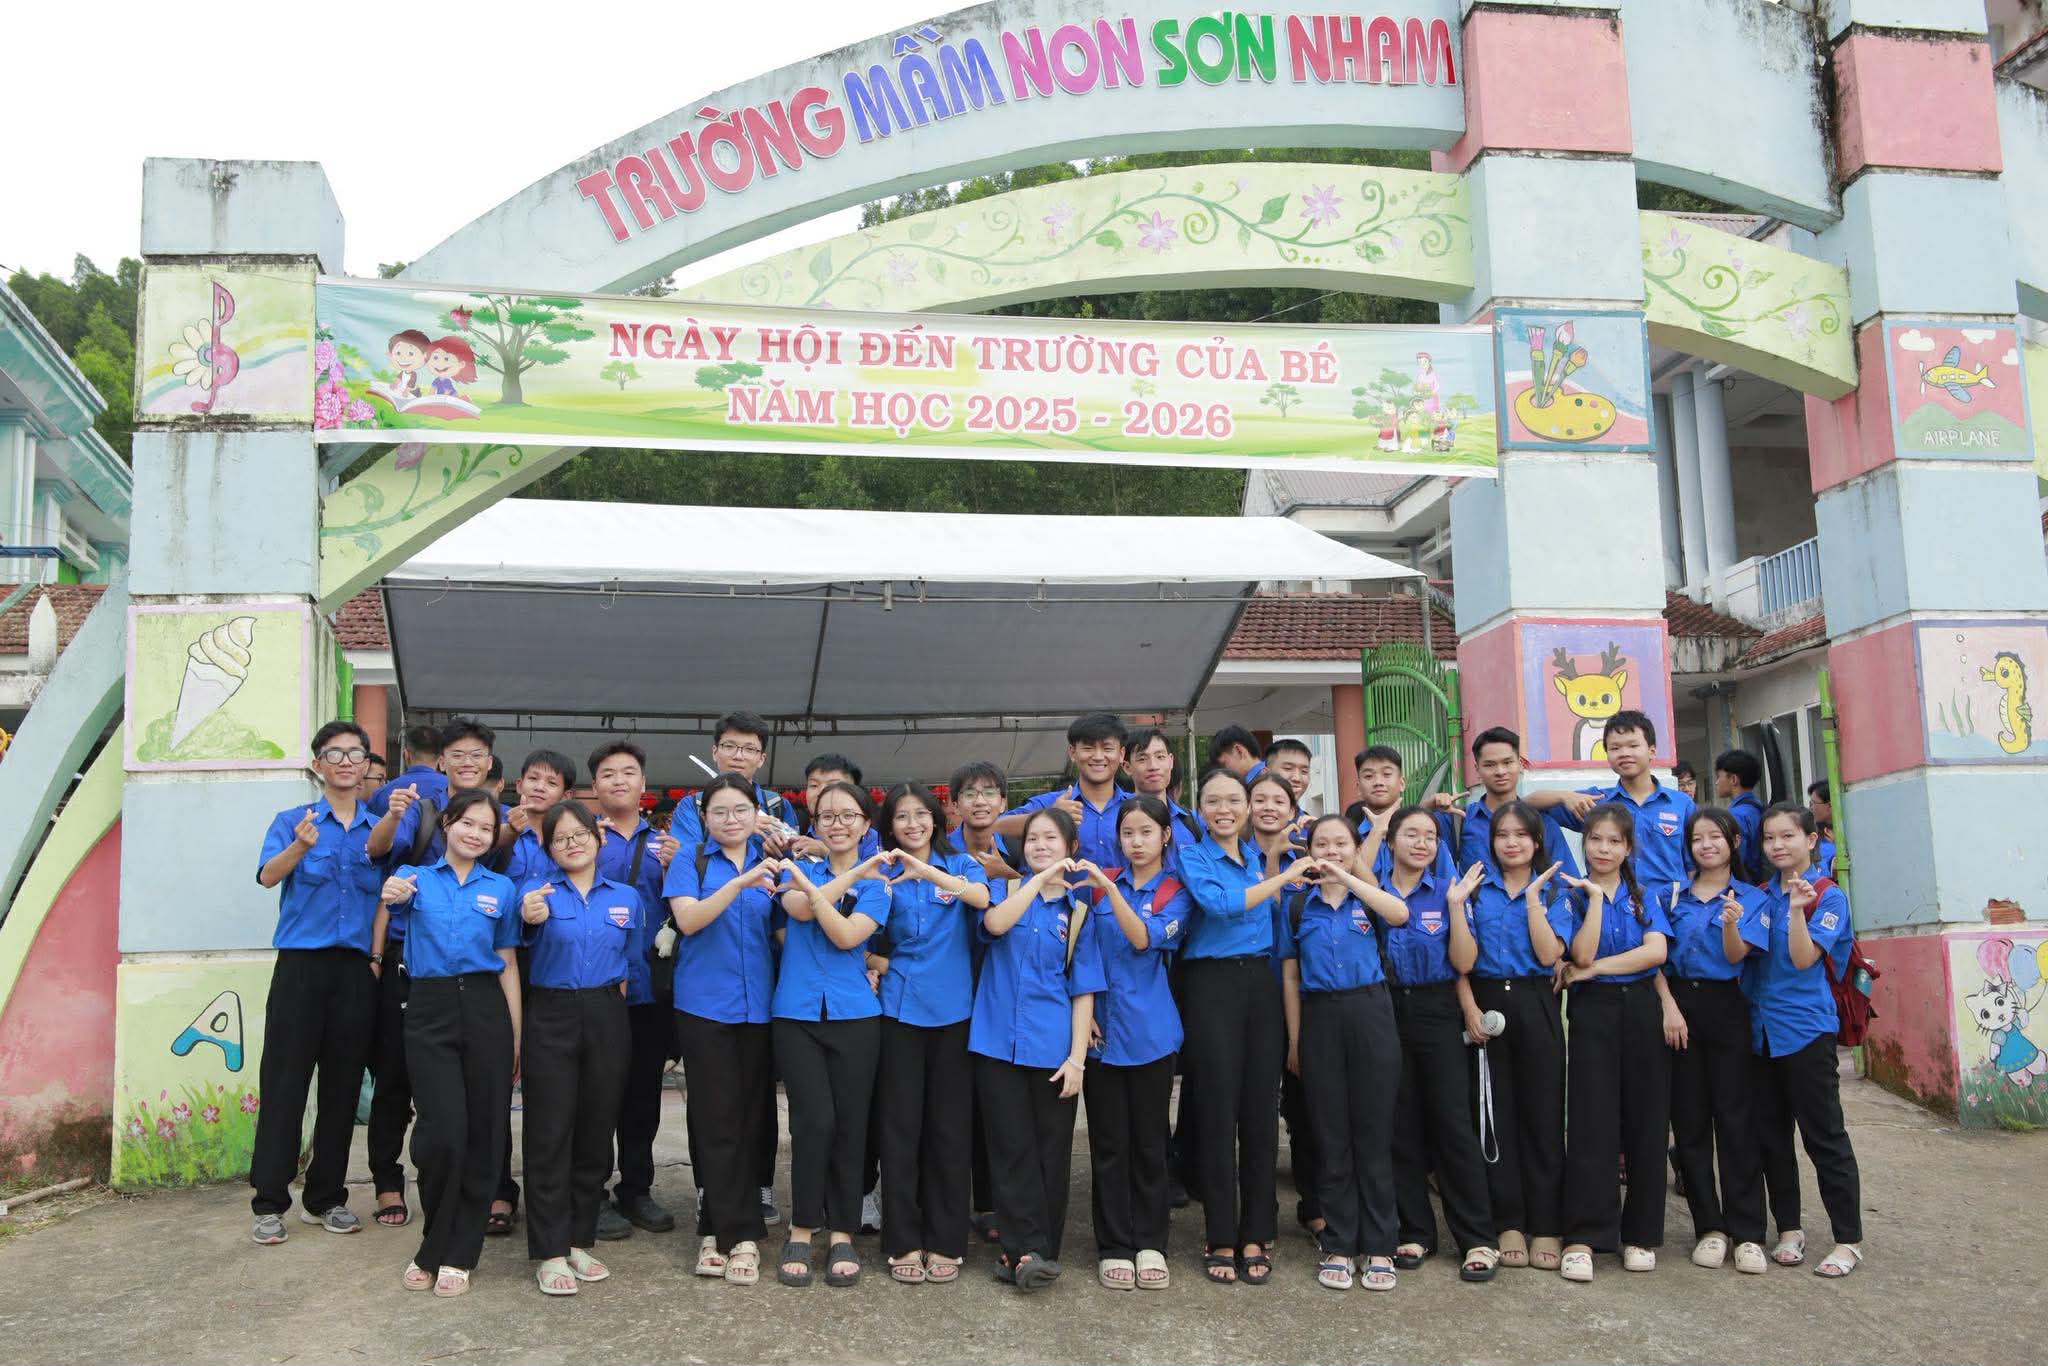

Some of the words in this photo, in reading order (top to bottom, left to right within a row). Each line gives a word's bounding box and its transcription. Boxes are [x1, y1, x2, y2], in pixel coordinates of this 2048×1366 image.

[576, 86, 847, 243] TRƯỜNG
[842, 24, 1007, 143] MẦM
[1000, 17, 1145, 100] NON
[1150, 10, 1279, 88] SƠN
[1287, 14, 1457, 86] NHAM
[609, 317, 743, 361] NGÀY
[756, 323, 842, 373] HỘI
[858, 324, 956, 369] ĐẾN
[972, 333, 1160, 377] TRƯỜNG
[1175, 336, 1268, 381] CỦA
[1279, 341, 1338, 384] BÉ
[727, 378, 836, 424] NĂM
[851, 391, 951, 436] HỌC
[966, 394, 1078, 433] 2025
[1123, 400, 1233, 438] 2026
[1923, 429, 2002, 448] AIRPLANE
[171, 990, 244, 1072] A
